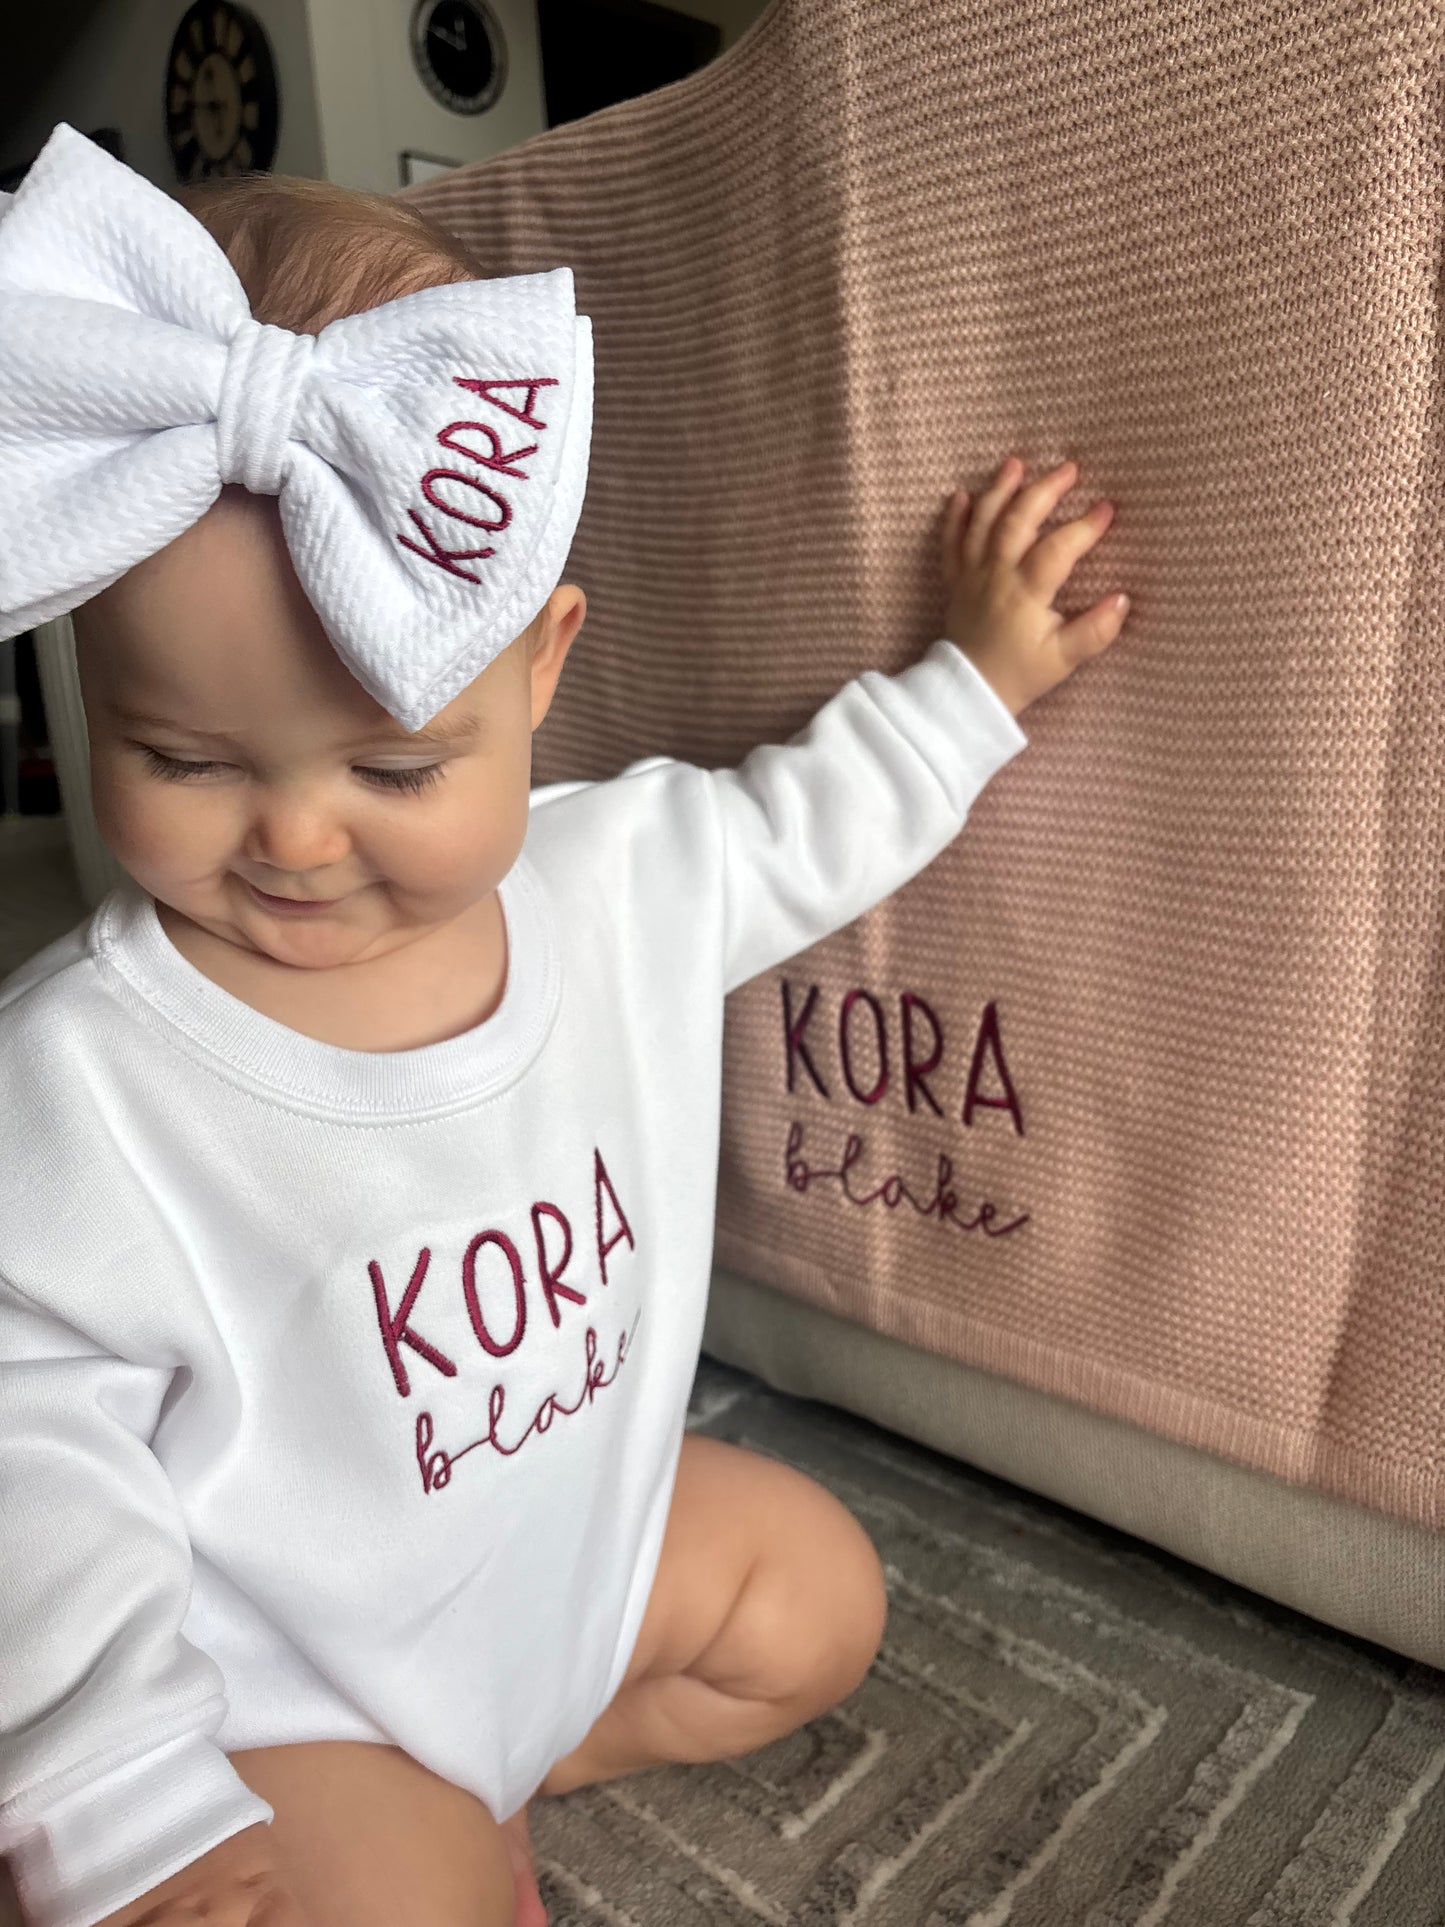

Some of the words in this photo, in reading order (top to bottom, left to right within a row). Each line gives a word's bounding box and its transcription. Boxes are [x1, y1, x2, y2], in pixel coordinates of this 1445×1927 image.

[397, 376, 559, 584] KORA
[780, 974, 1025, 1136] KORA
[785, 1121, 1030, 1237] blake
[368, 1146, 635, 1398] KORA
